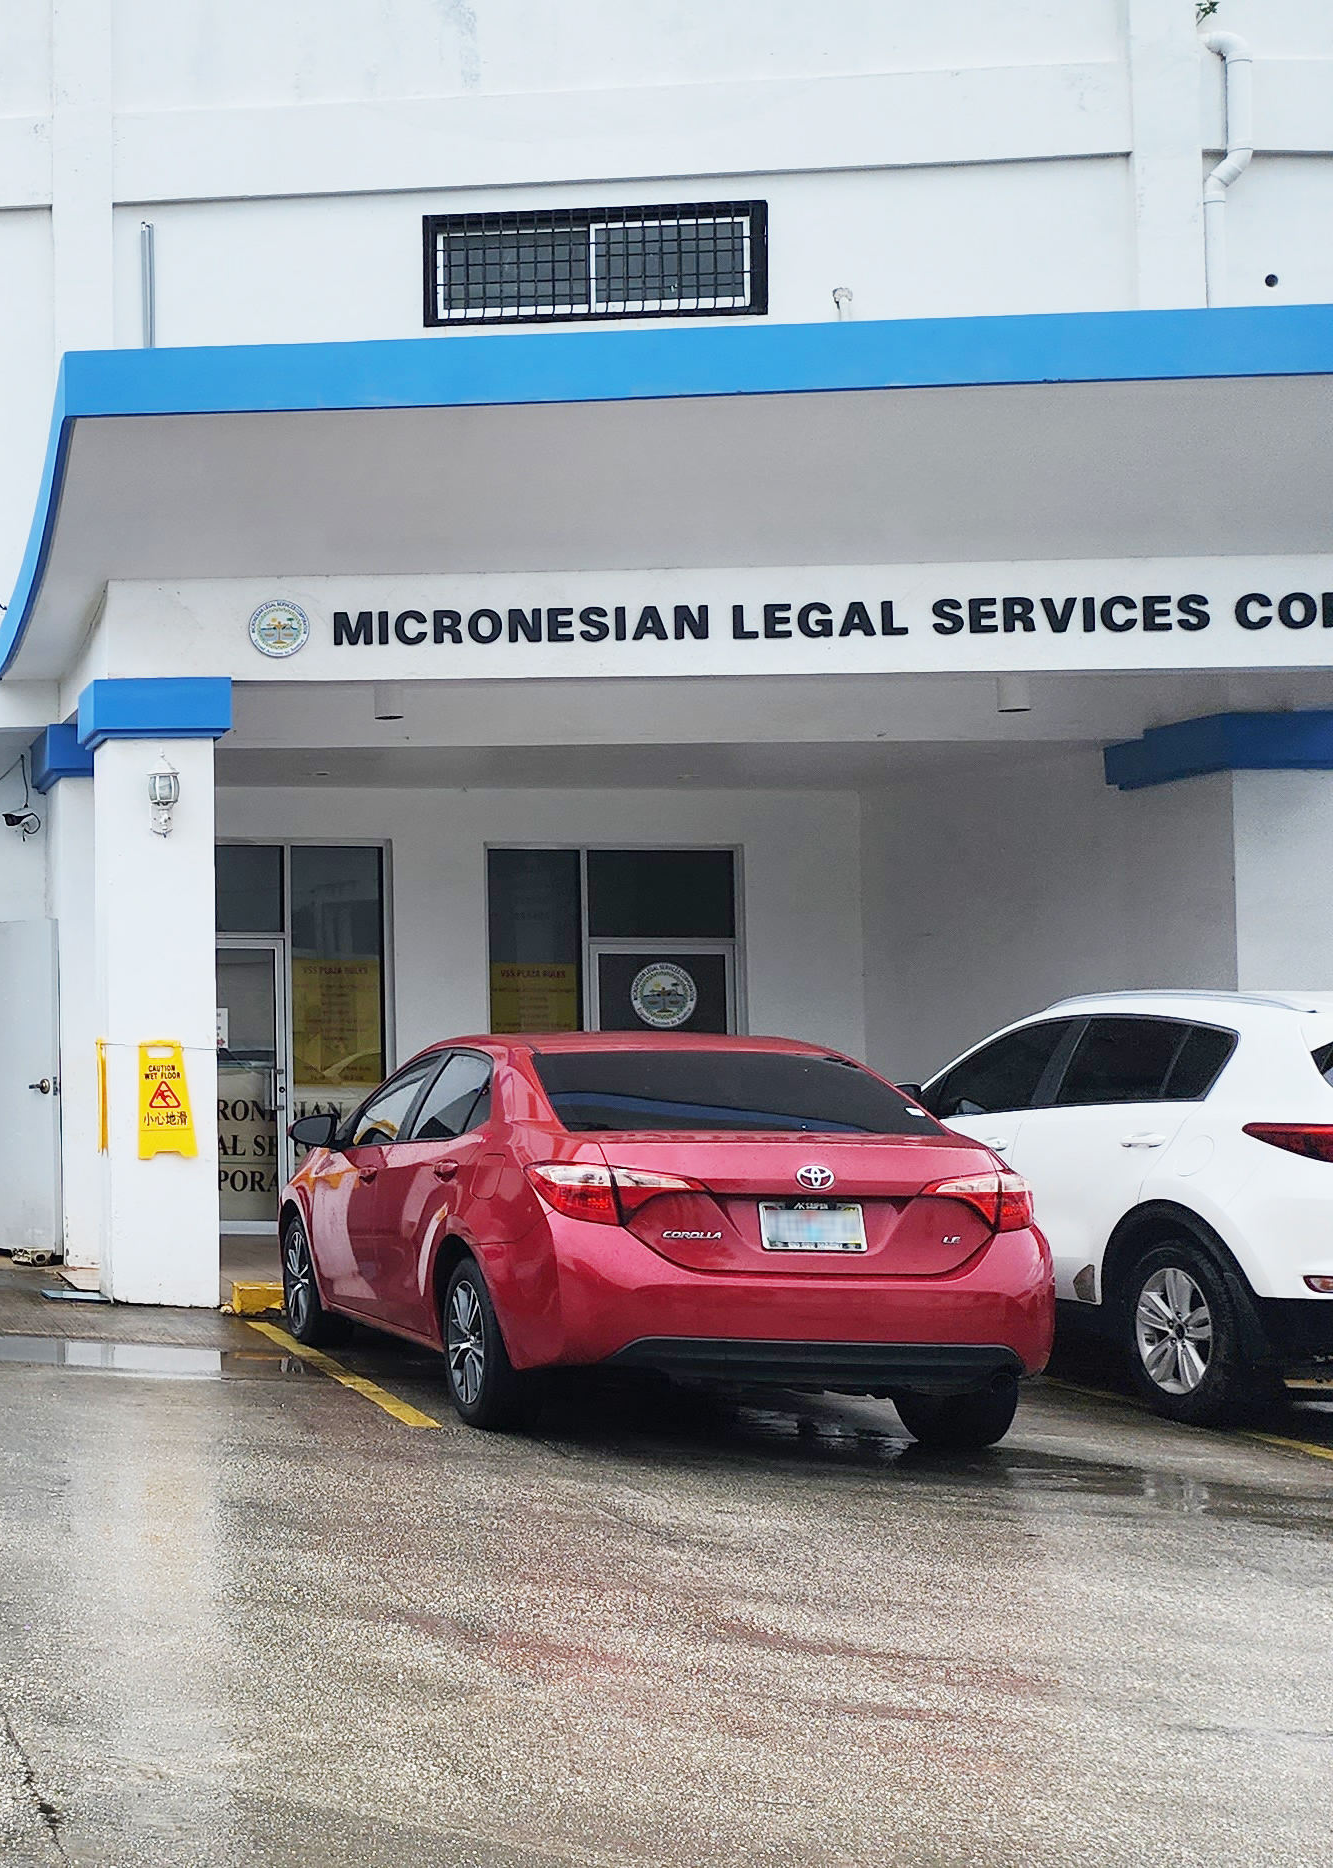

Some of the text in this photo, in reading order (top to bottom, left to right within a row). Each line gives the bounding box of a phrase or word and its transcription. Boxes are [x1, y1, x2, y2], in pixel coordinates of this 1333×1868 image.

[333, 604, 709, 646] MICRONESIAN
[732, 600, 909, 640] LEGAL
[932, 594, 1211, 635] SERVICES
[148, 1064, 176, 1072] CAUTION
[144, 1071, 181, 1080] WET FLOOR
[143, 1110, 188, 1126] 小心地滑
[662, 1230, 722, 1239] COROLLA
